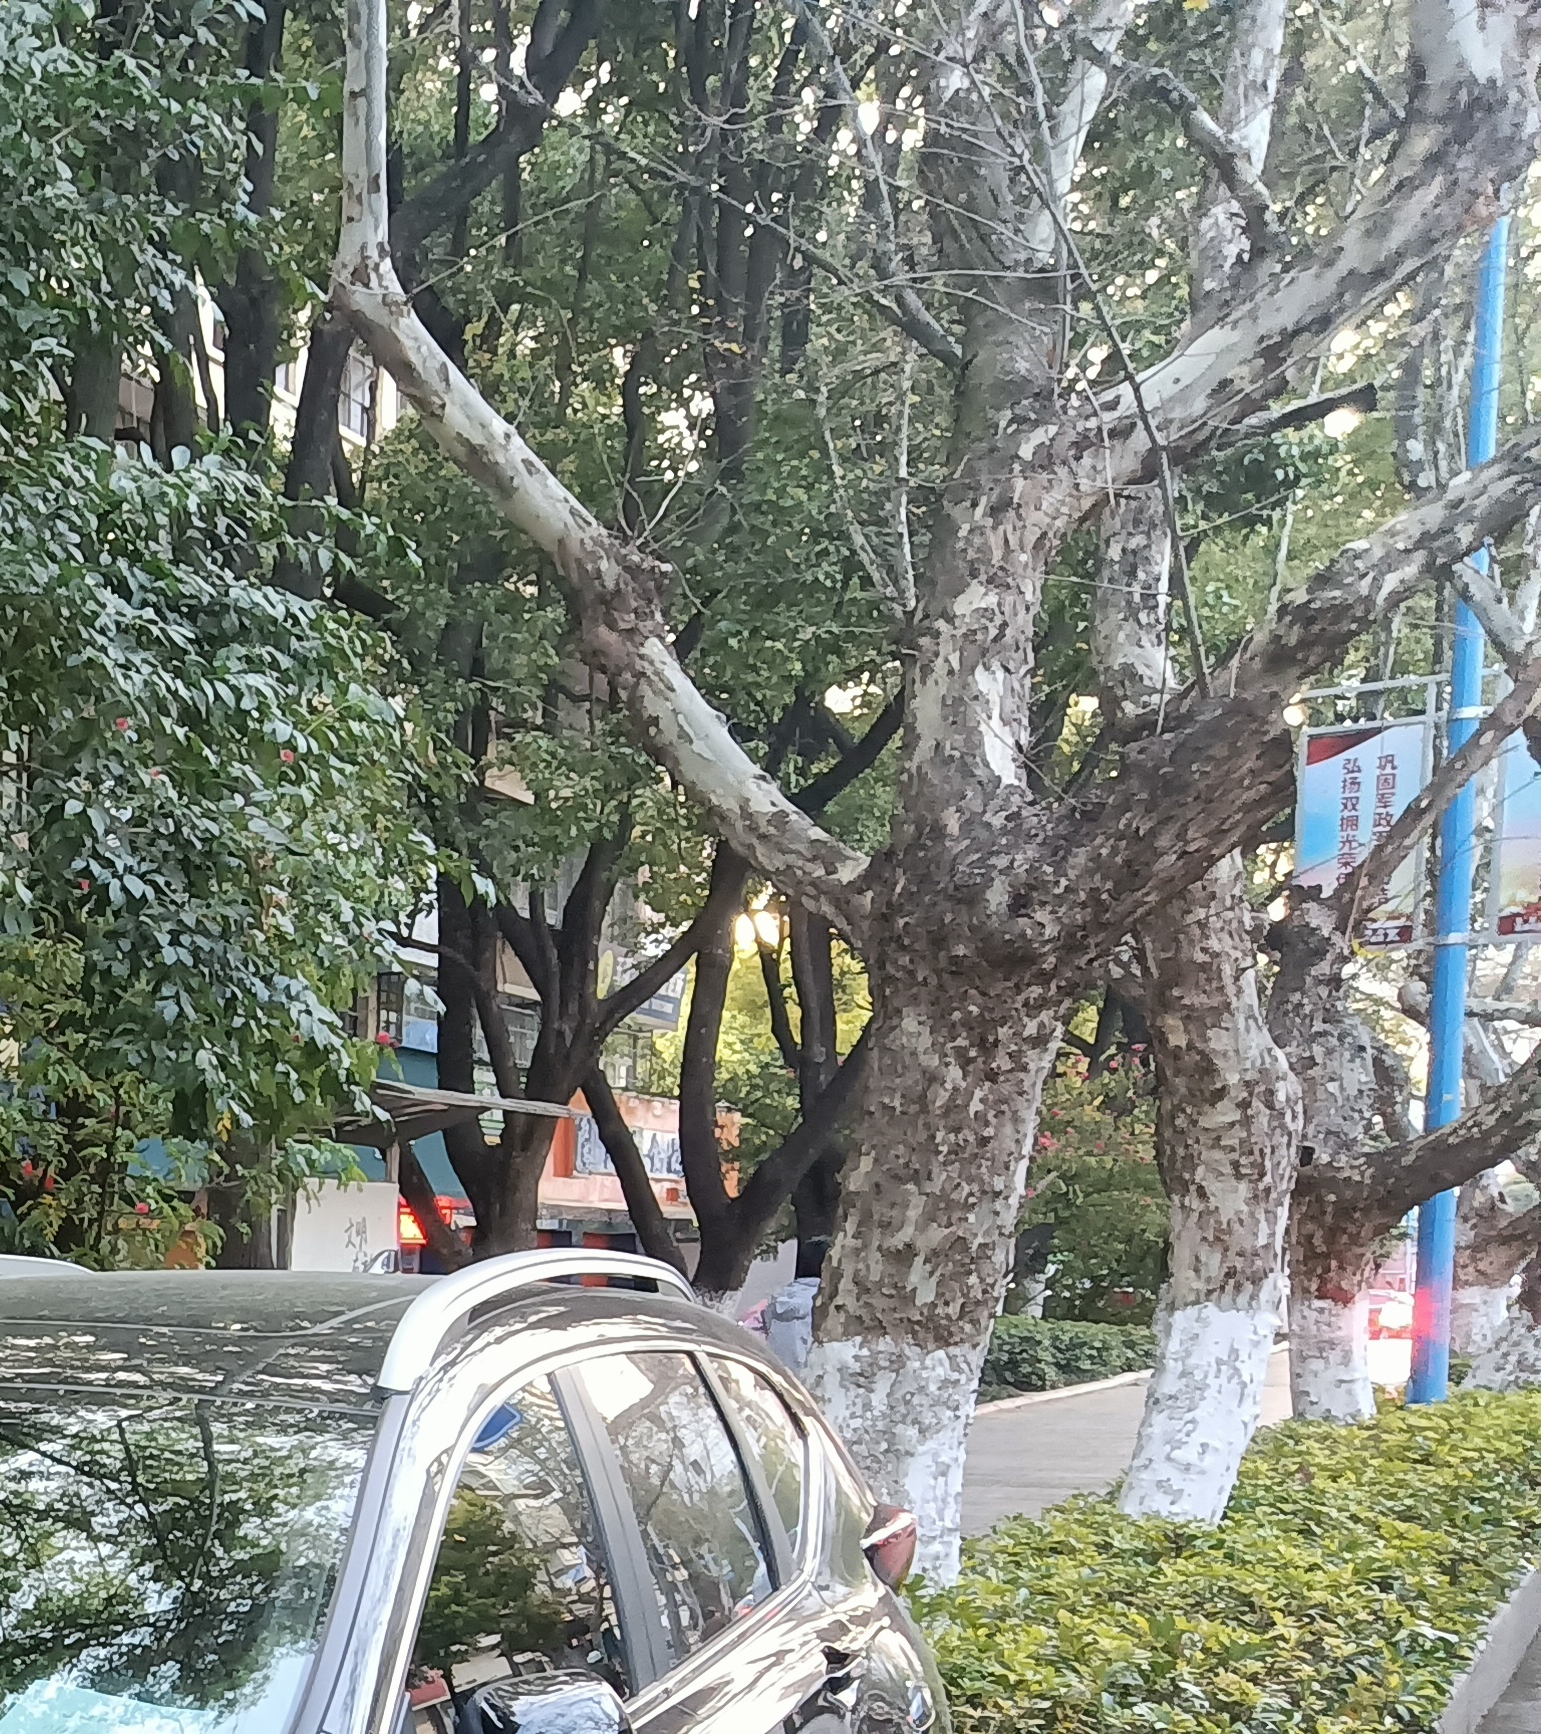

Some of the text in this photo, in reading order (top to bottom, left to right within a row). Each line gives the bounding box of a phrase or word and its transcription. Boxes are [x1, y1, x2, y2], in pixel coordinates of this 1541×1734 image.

[1336, 757, 1362, 886] 弘扬双拥光荣
